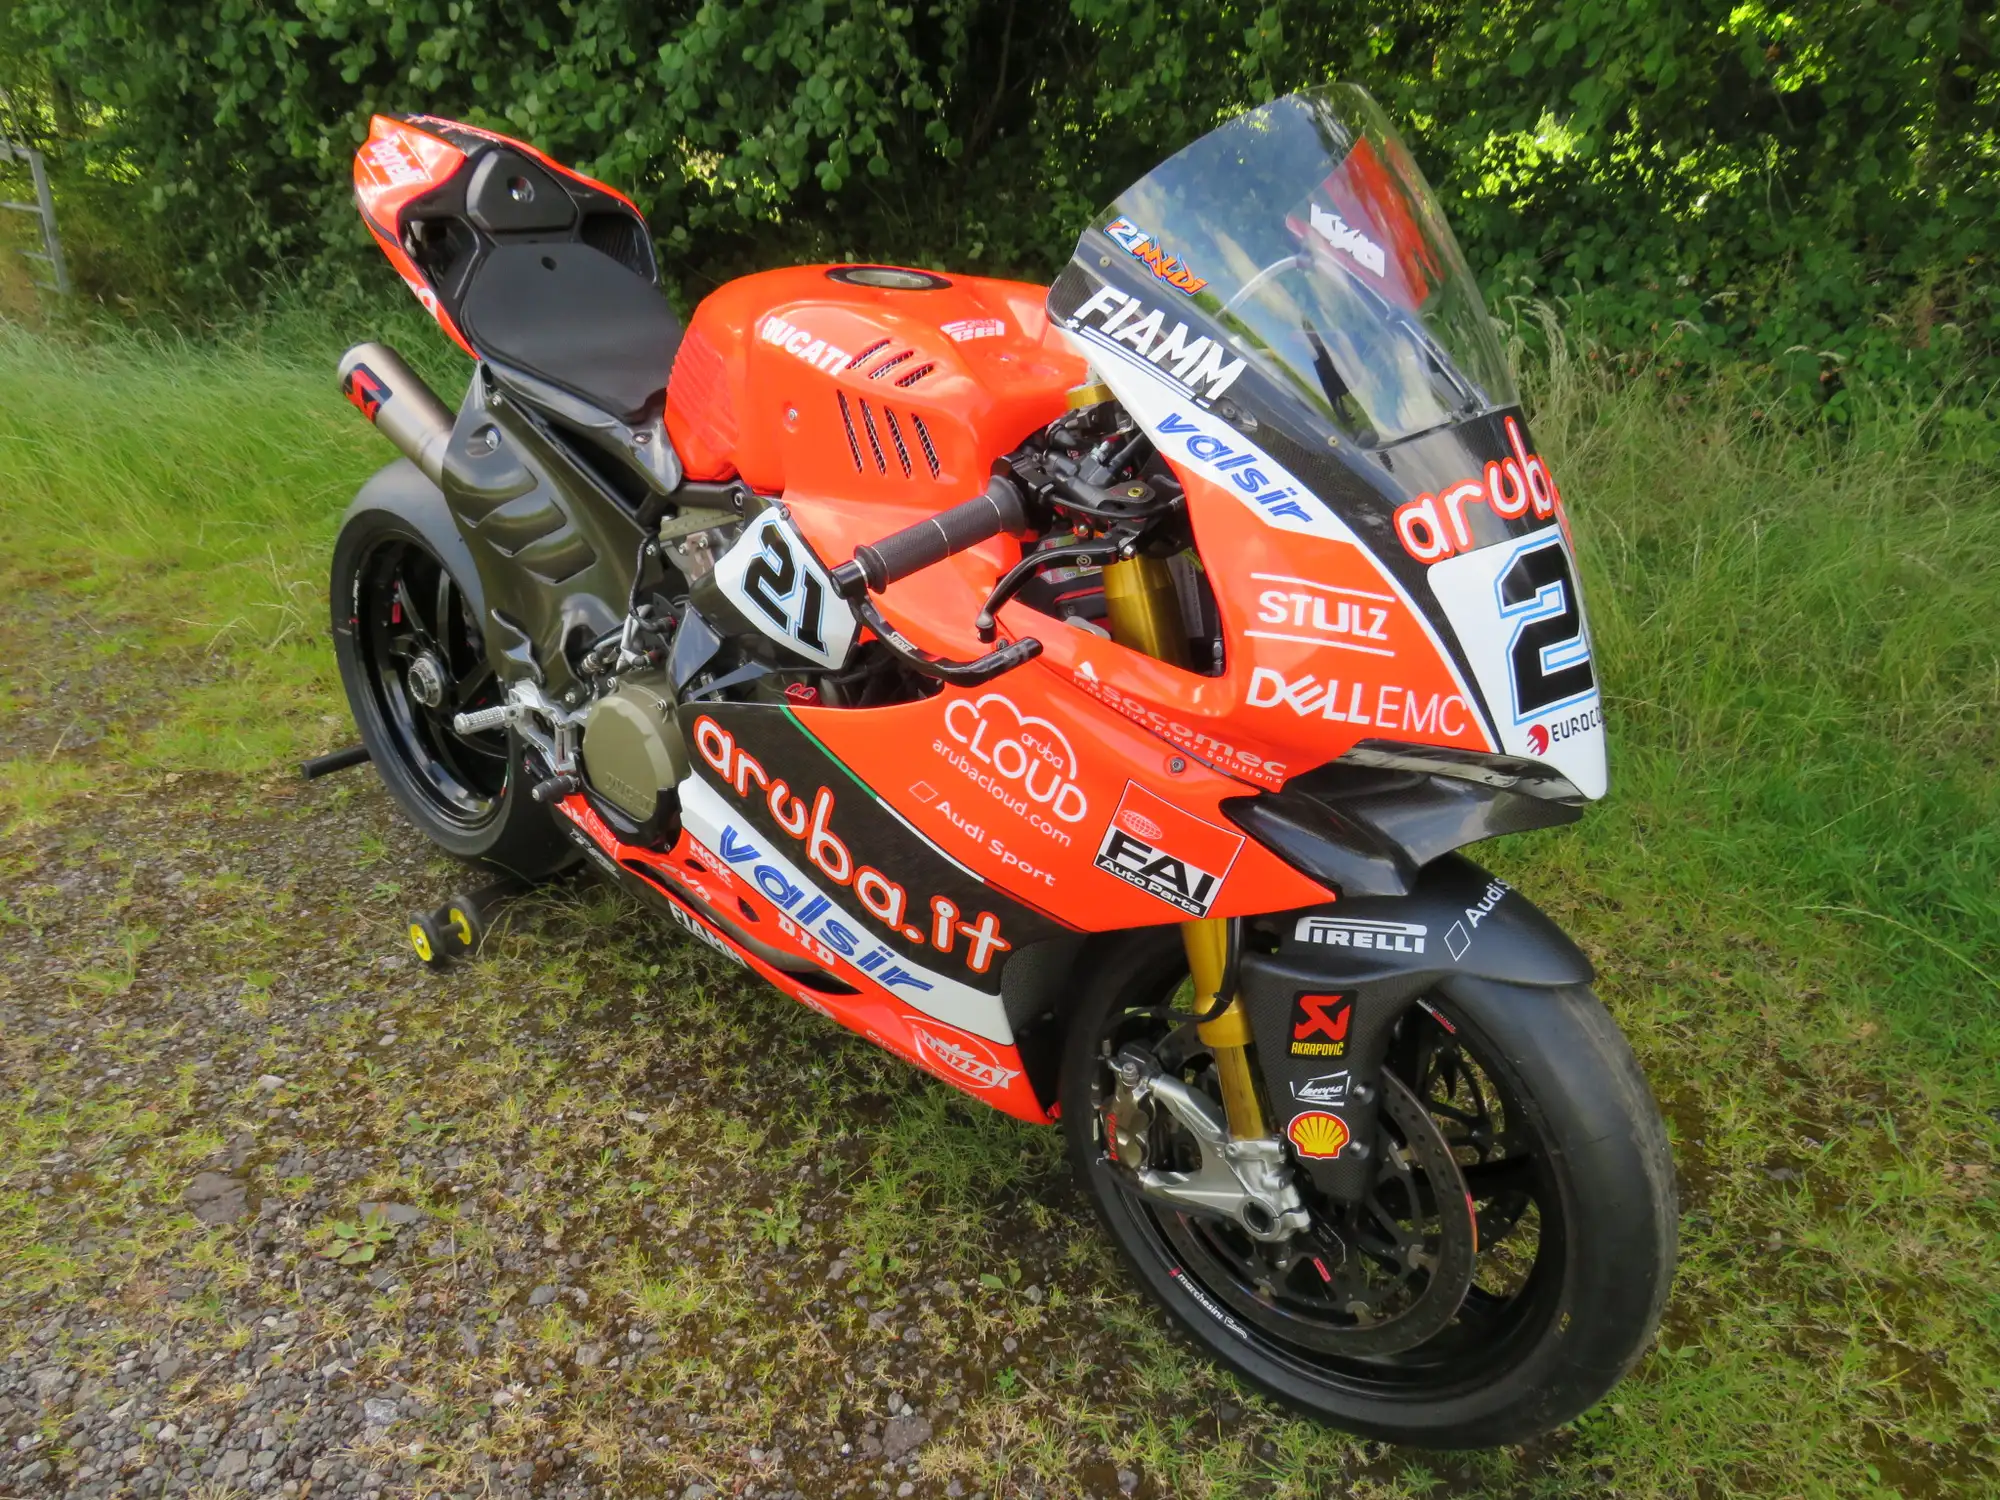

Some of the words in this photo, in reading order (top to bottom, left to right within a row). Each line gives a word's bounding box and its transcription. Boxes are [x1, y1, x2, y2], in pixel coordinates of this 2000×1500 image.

[762, 316, 852, 376] DUCATI
[1073, 286, 1247, 400] FIAMM
[1156, 413, 1313, 523] valsir
[1395, 418, 1554, 562] arub
[741, 519, 829, 657] 21
[1257, 590, 1388, 641] STULZ
[944, 698, 1088, 823] CLOUD
[1021, 733, 1064, 769] aruba
[1155, 725, 1200, 750] Power
[1207, 751, 1284, 784] Solutions
[932, 739, 1072, 847] arubacloud.com
[695, 717, 1009, 971] aruba.it
[935, 801, 985, 843] Audi
[987, 838, 1056, 887] Sport
[1105, 829, 1215, 903] FAI
[720, 825, 934, 992] valsir
[1099, 859, 1146, 887] Auto
[1147, 881, 1201, 914] Parts
[1465, 883, 1506, 928] Audi
[778, 912, 835, 966] D.I.D
[1295, 916, 1427, 954] PIRELLI
